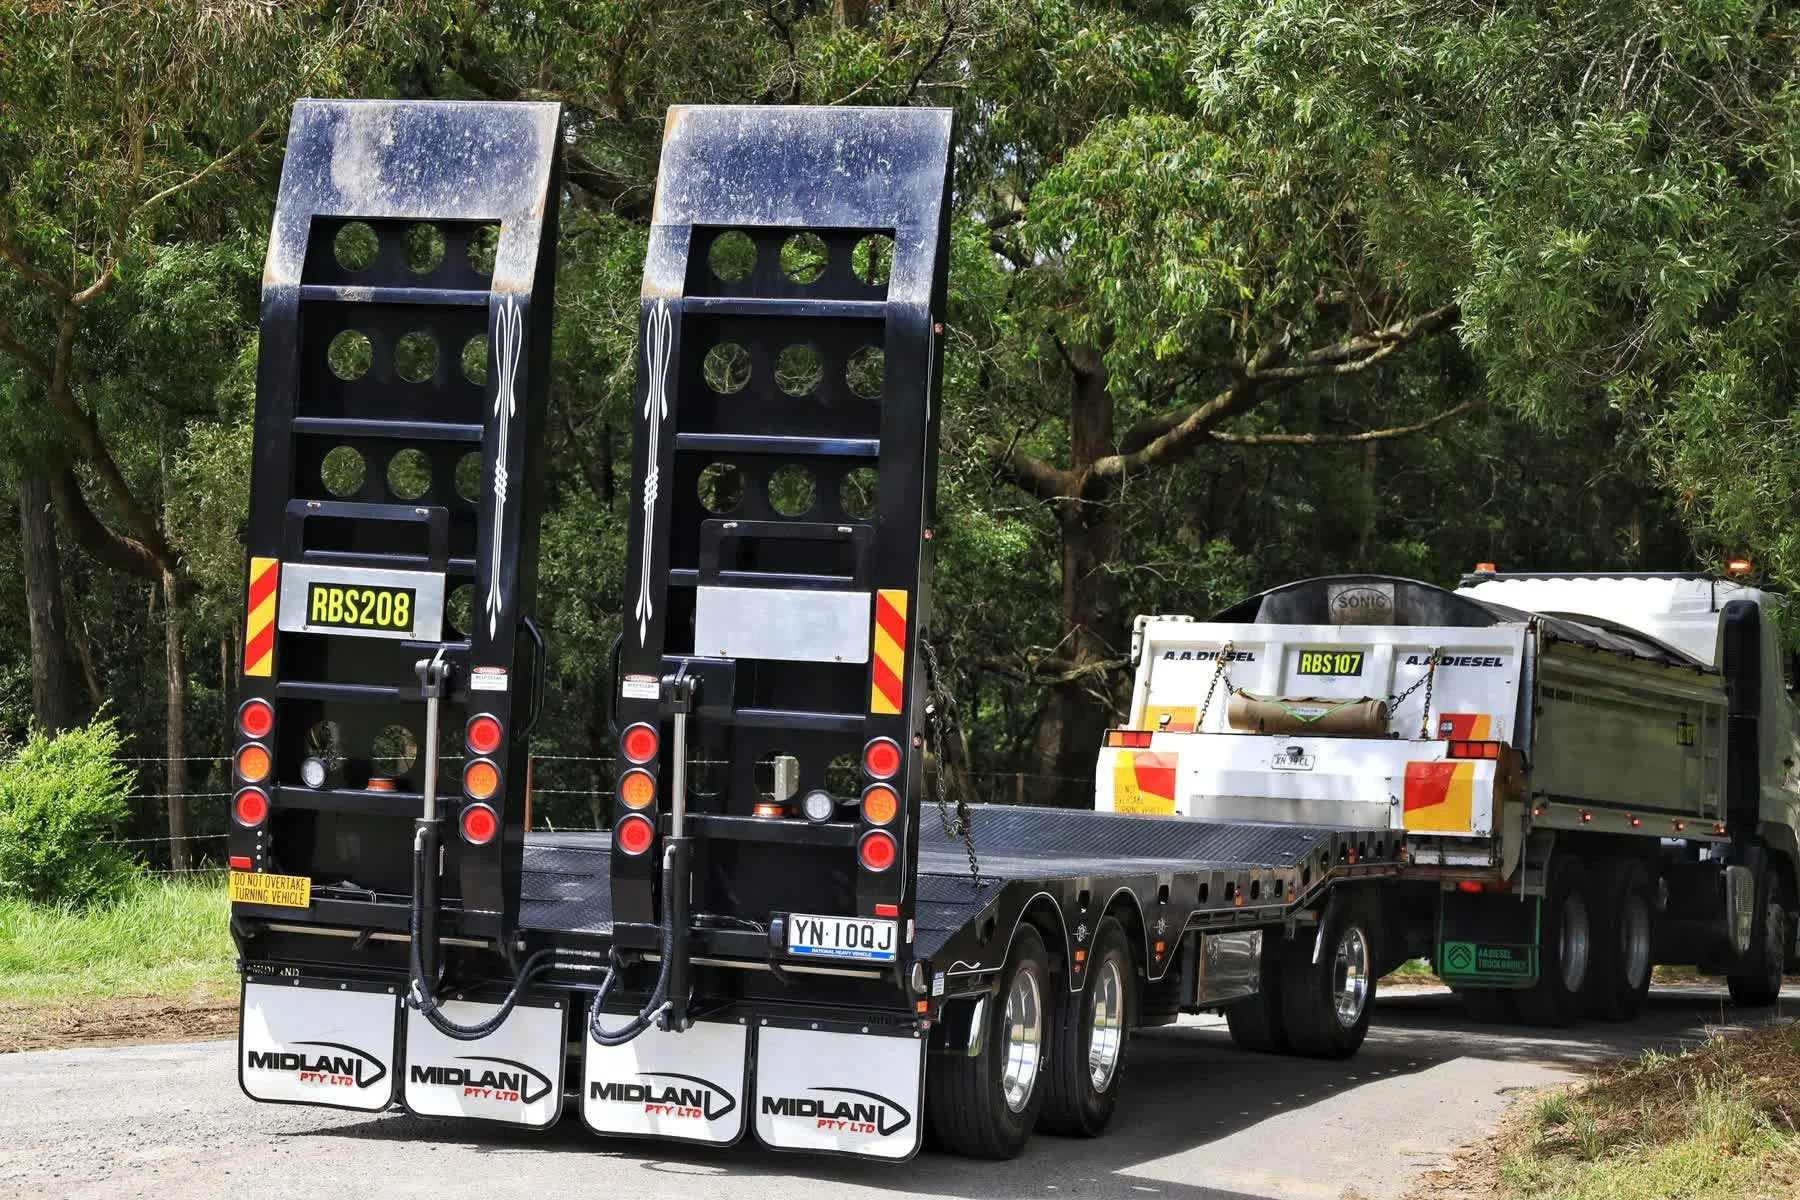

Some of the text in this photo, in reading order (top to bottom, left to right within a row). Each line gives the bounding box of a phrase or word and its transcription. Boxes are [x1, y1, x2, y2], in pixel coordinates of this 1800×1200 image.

[311, 587, 410, 627] RBS208
[1338, 594, 1385, 609] SONIC
[1163, 651, 1256, 662] A.A.DISEL
[1301, 653, 1361, 674] RBS107
[234, 872, 306, 892] DO NOT OVERTAKE
[234, 886, 305, 906] TURNING VEHICLE
[299, 1071, 354, 1086] PTY LTD
[463, 1087, 519, 1102] PTY LTD
[644, 1103, 703, 1119] PTY LTD
[816, 1118, 876, 1134] PTY LTD
